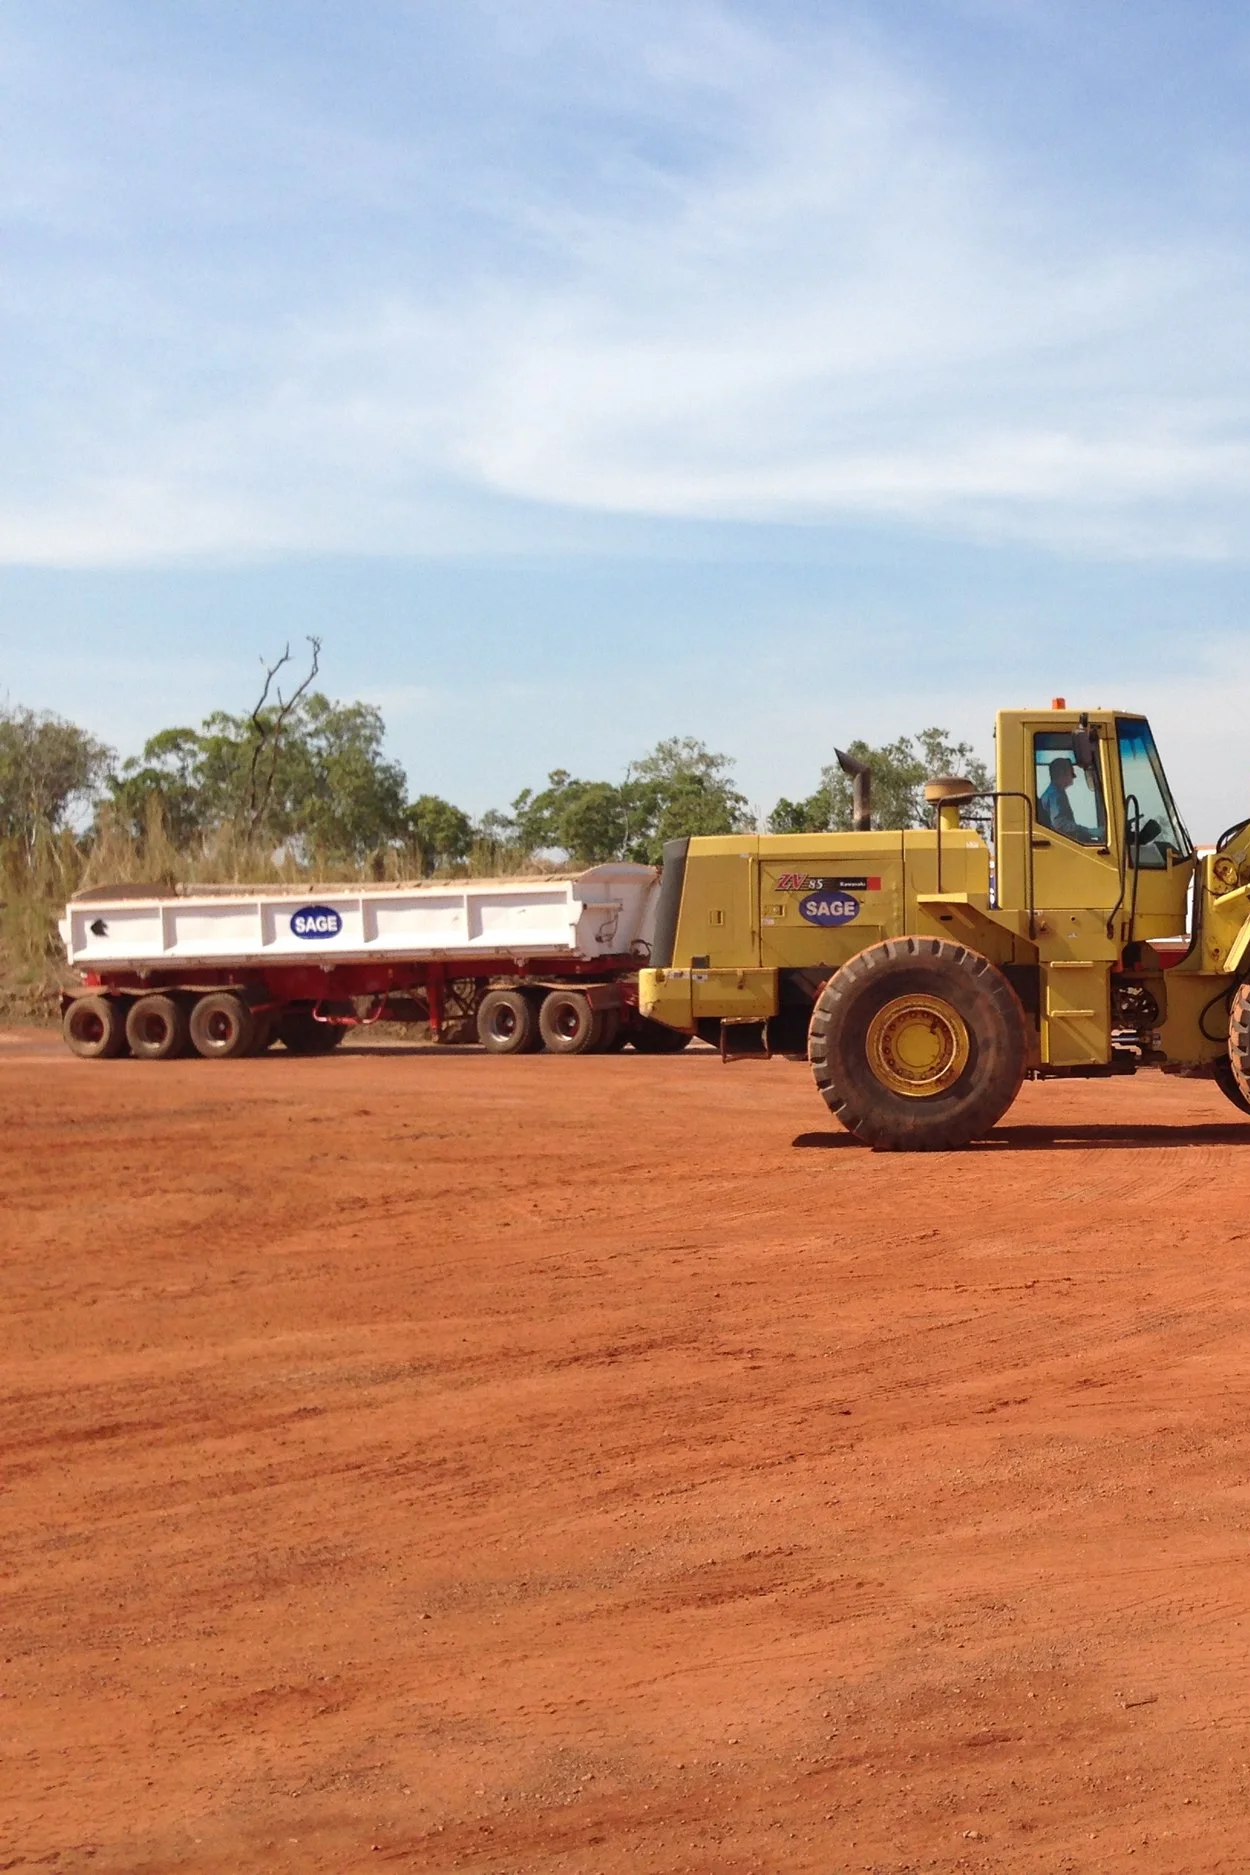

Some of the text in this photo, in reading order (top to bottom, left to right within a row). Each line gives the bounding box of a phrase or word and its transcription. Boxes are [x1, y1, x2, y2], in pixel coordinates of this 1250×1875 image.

[808, 879, 823, 890] 85
[805, 901, 855, 916] SAGE
[295, 915, 338, 933] SAGE
